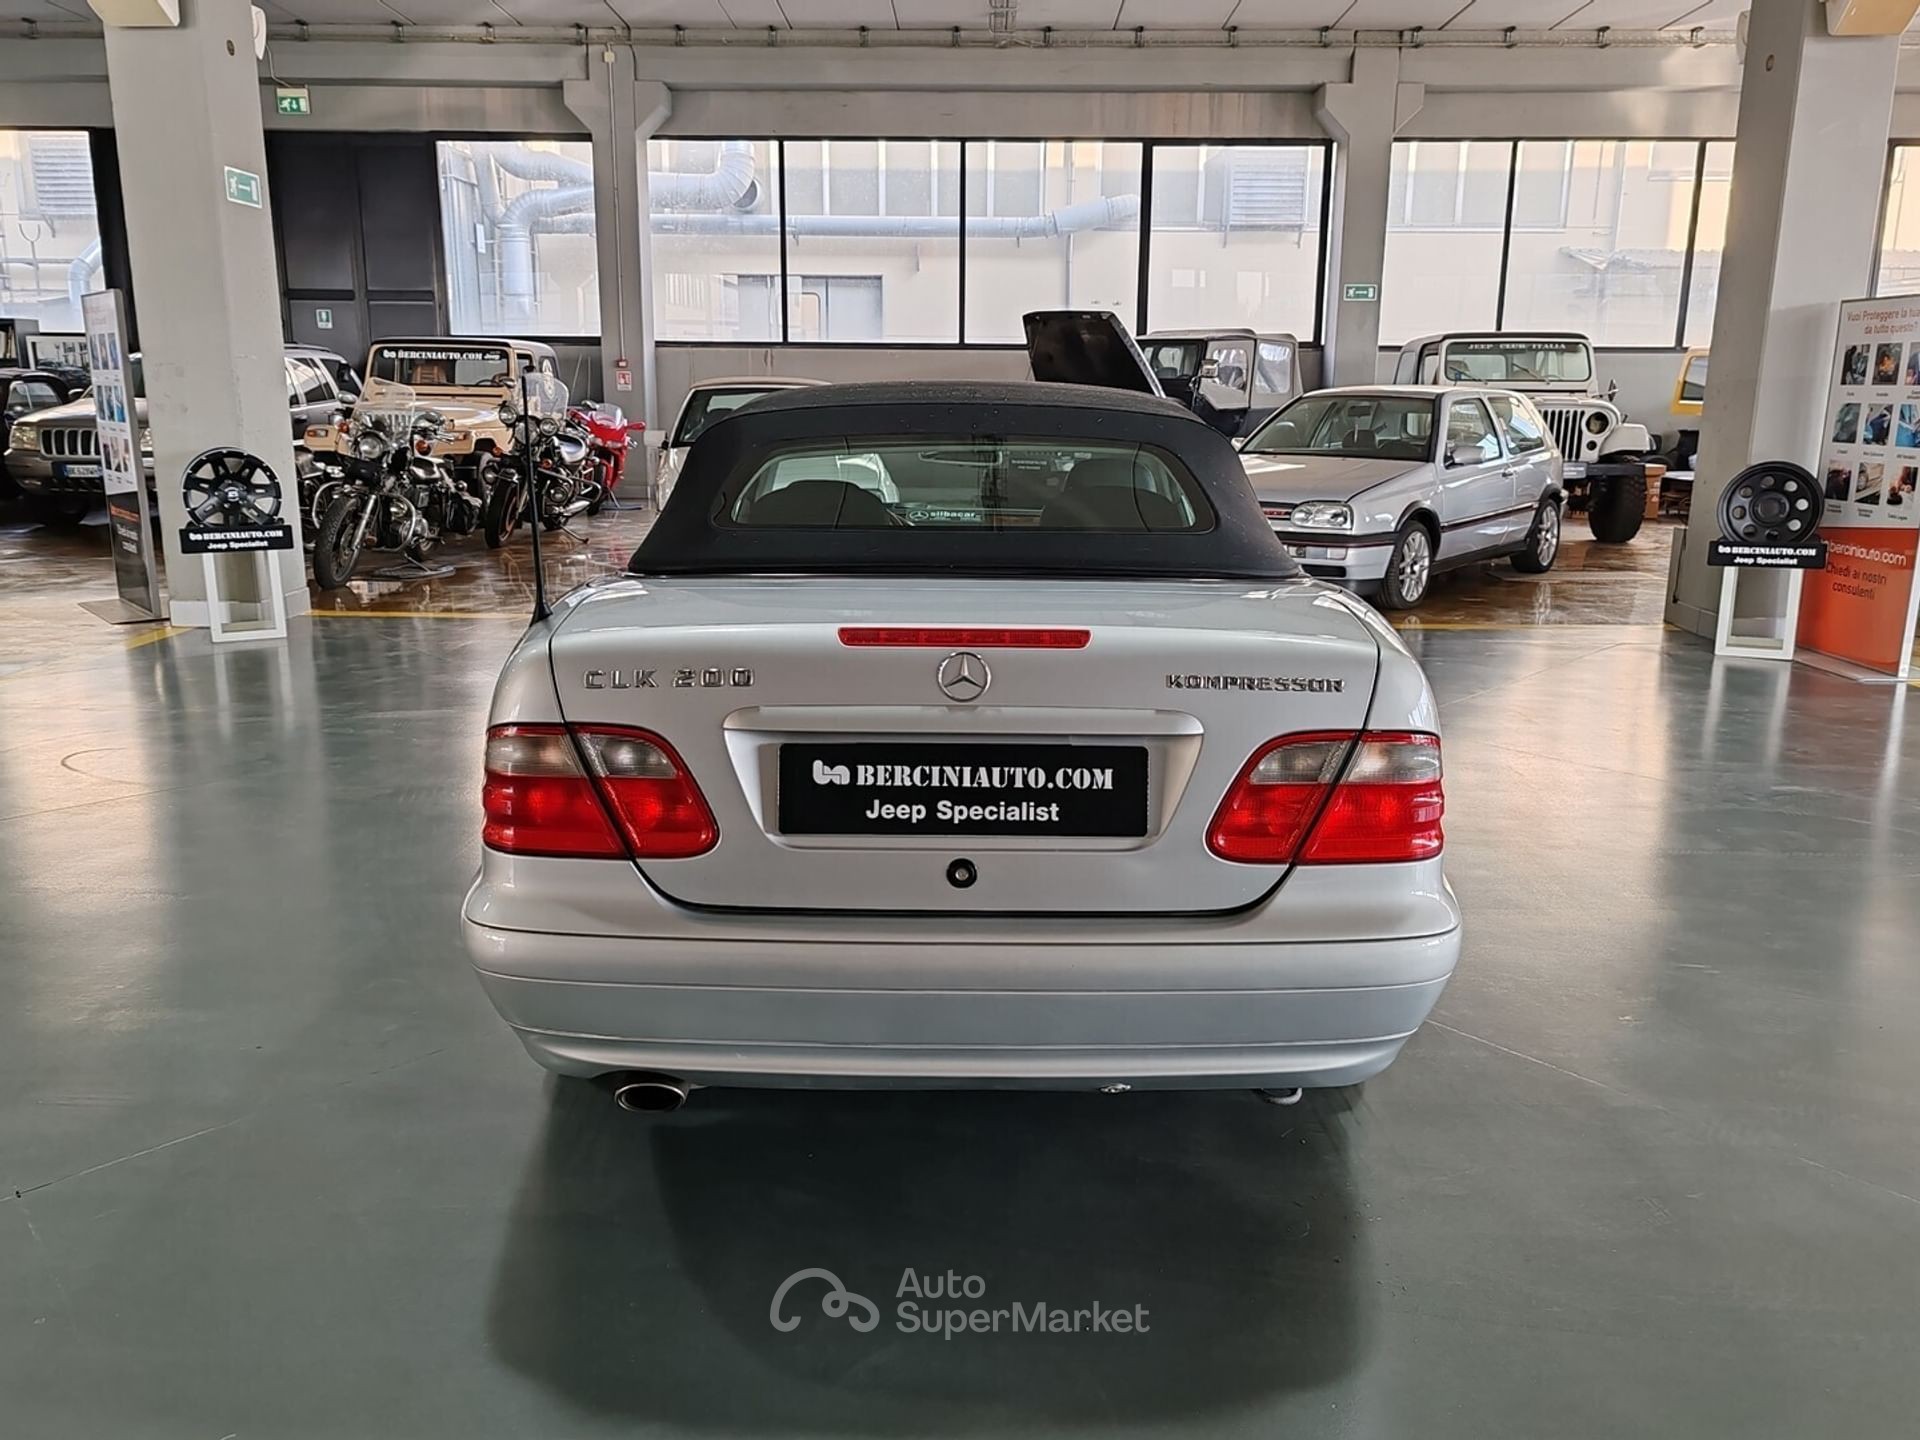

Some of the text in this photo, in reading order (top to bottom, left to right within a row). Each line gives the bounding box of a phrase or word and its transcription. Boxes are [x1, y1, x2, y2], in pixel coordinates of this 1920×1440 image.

[398, 349, 482, 361] BERCINIAUTO.COM
[203, 530, 284, 540] BERCINIAUTO.COM
[207, 541, 269, 550] Jeep Specialist
[1732, 546, 1817, 557] BERCINIAUTO.COM
[1733, 556, 1798, 566] Jeep Specialist
[1826, 561, 1850, 577] Chiedi
[1832, 581, 1876, 601] consulenti
[583, 667, 756, 690] CLK 200
[1166, 674, 1346, 693] KOMPRESSOR
[856, 763, 1113, 791] BERCINIAUTO.COM
[866, 799, 1060, 824] Jeep Specialist
